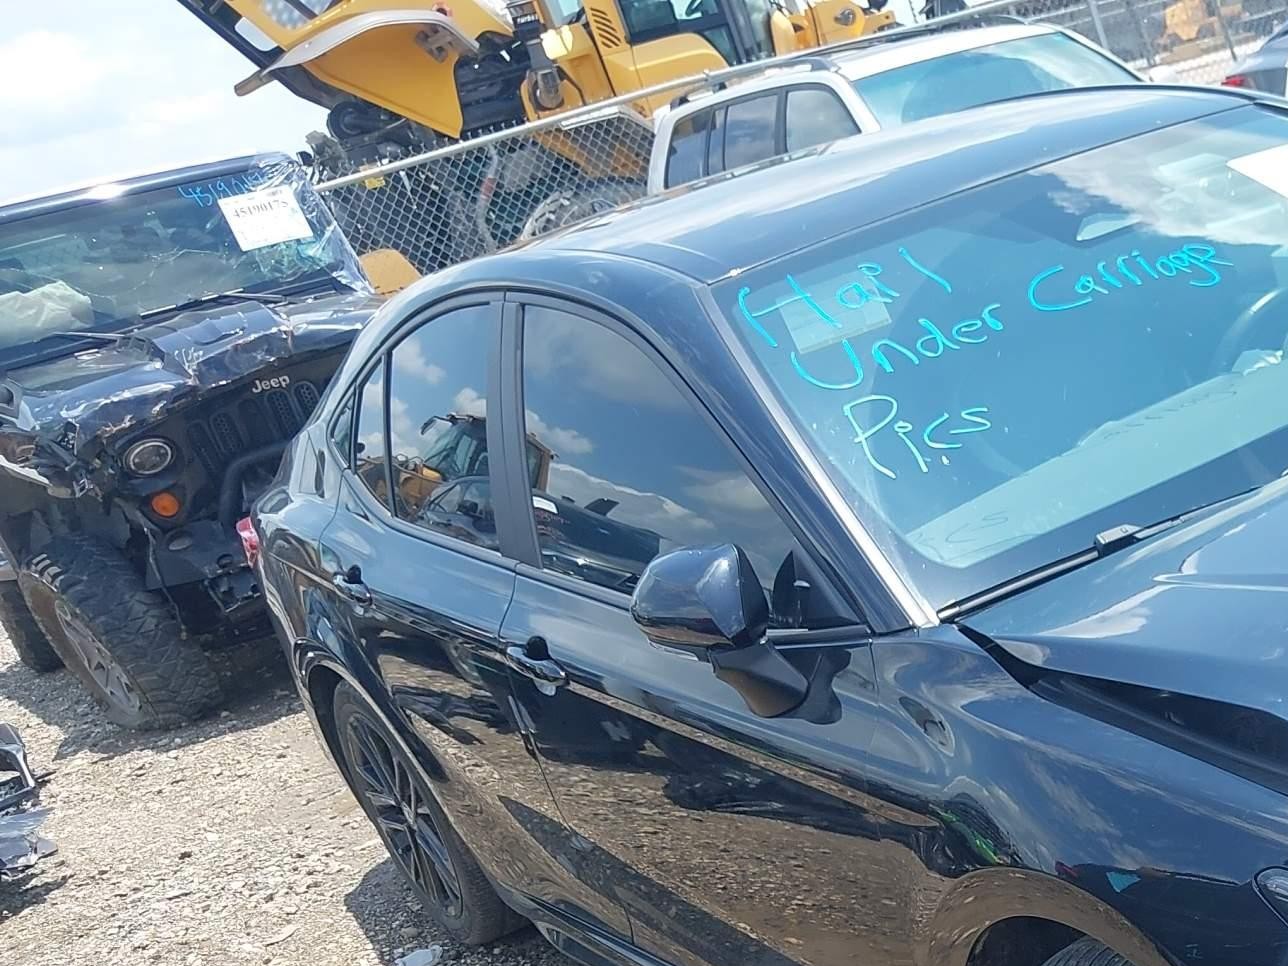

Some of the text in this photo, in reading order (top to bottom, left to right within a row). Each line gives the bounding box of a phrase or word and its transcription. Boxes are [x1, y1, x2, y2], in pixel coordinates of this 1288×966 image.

[738, 247, 952, 348] Hail
[252, 375, 290, 393] Jeep
[790, 303, 1004, 390] Under
[843, 394, 993, 480] Pics
